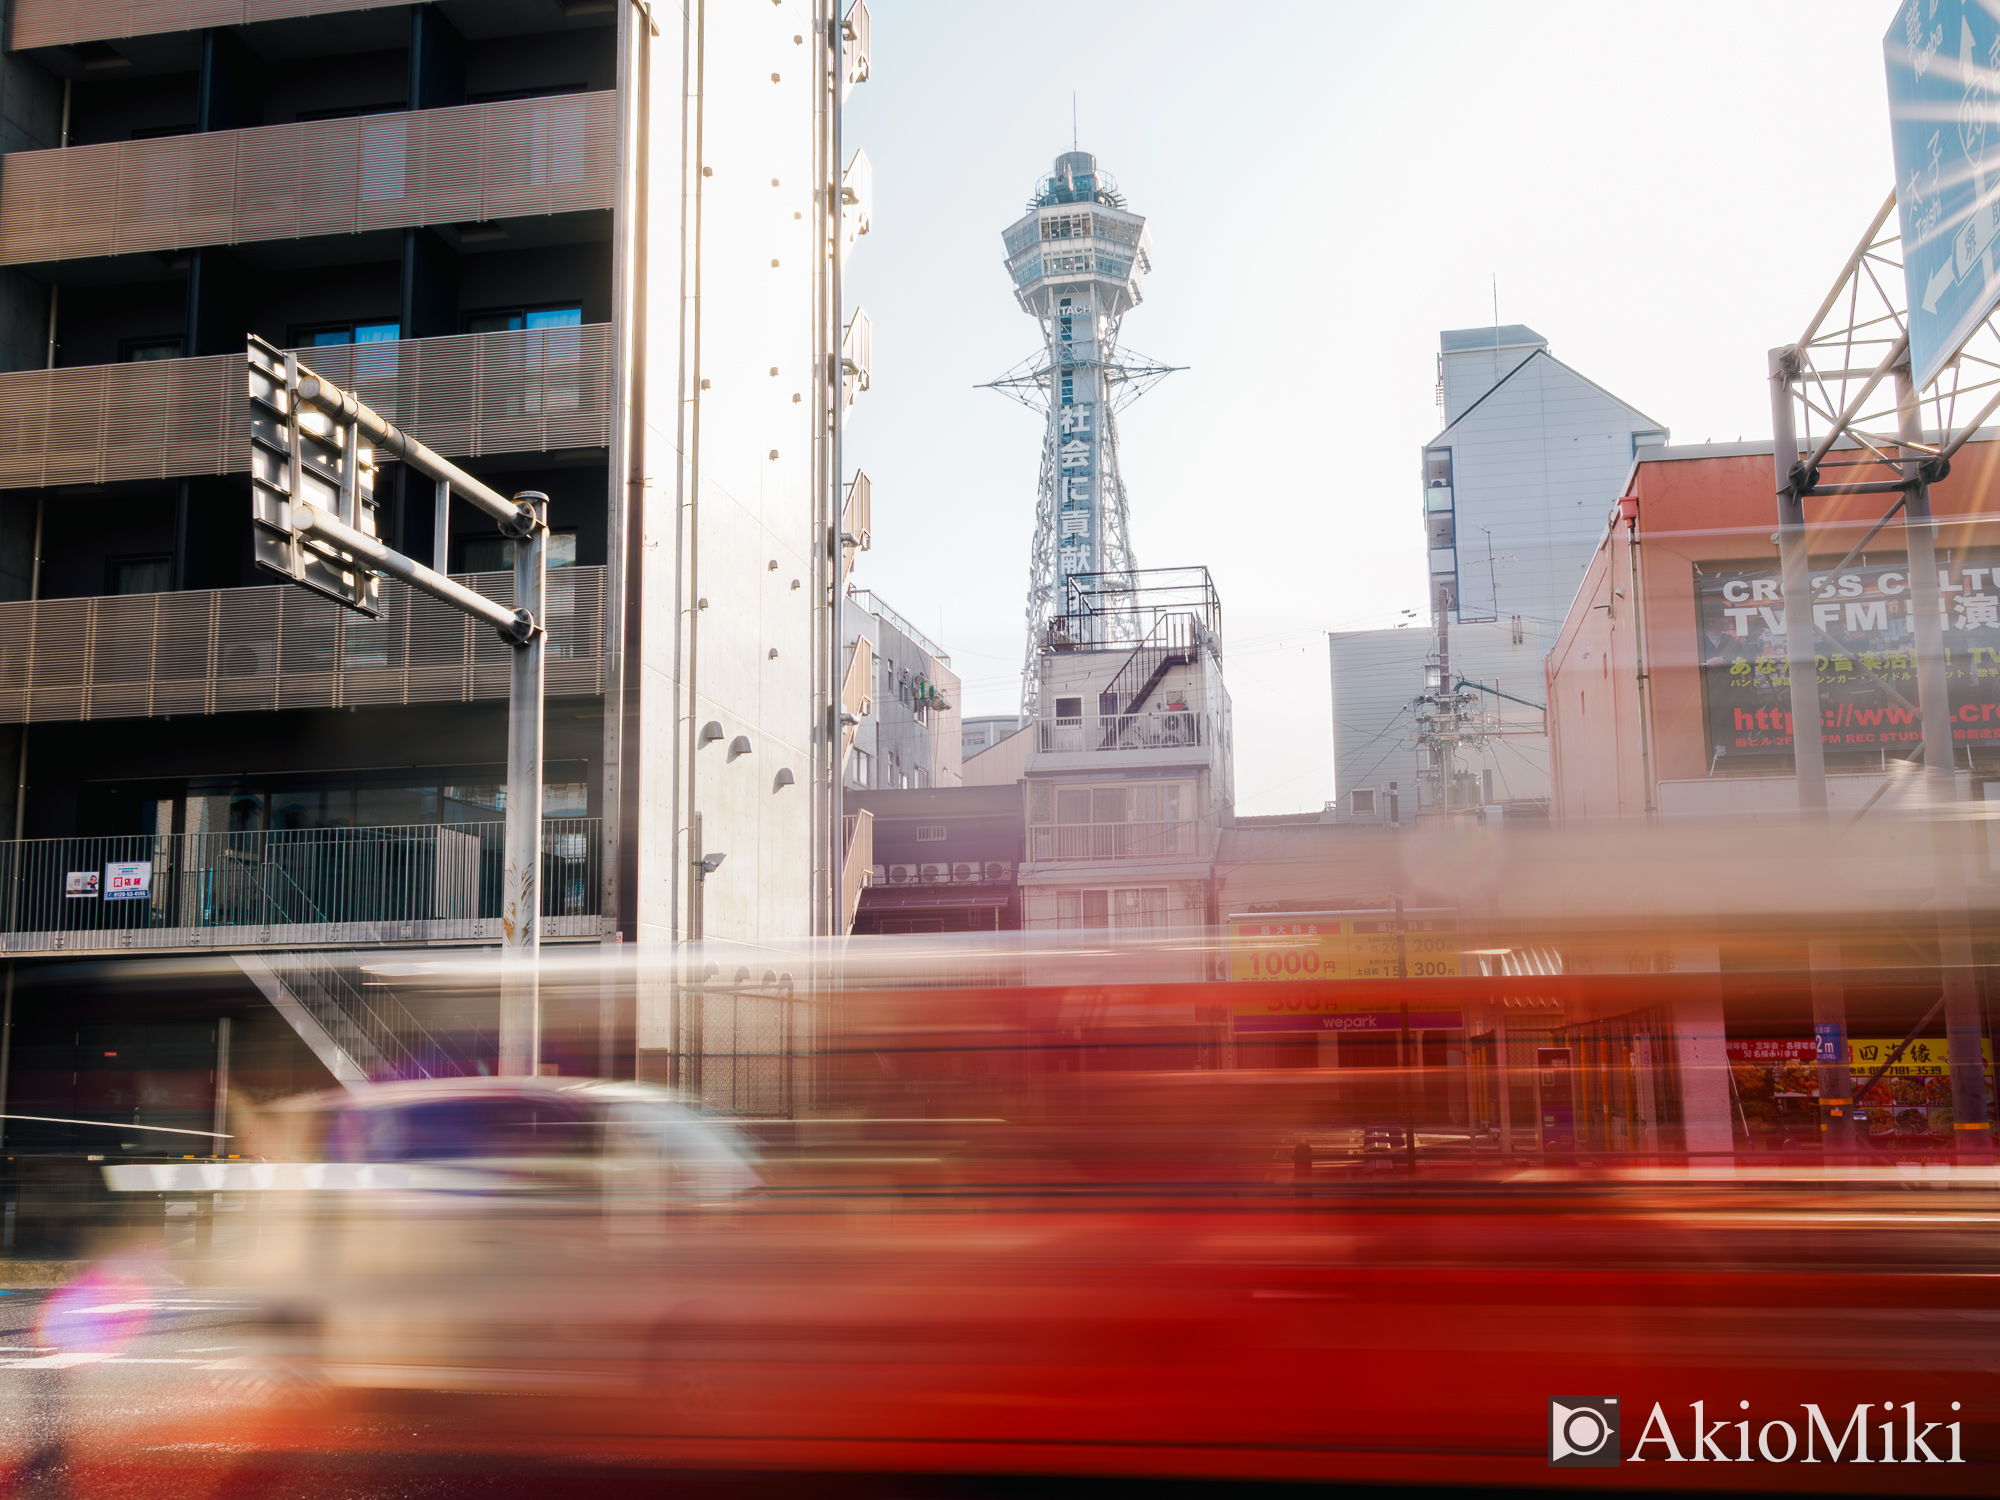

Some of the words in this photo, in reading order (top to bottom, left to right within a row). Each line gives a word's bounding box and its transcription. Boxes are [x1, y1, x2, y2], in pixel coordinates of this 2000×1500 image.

[1914, 23, 1943, 84] Nanba
[1963, 84, 1984, 150] 25
[1906, 129, 1943, 222] 太子
[1915, 190, 1942, 245] Taishi
[1047, 304, 1095, 316] HITACHI
[1723, 573, 1863, 602] CRSS
[1877, 567, 2000, 595] CLT
[1845, 733, 1875, 743] REC
[1260, 923, 1318, 935] 最大料金
[1356, 968, 1379, 976] 土日祝
[1323, 1014, 1377, 1030] wepark
